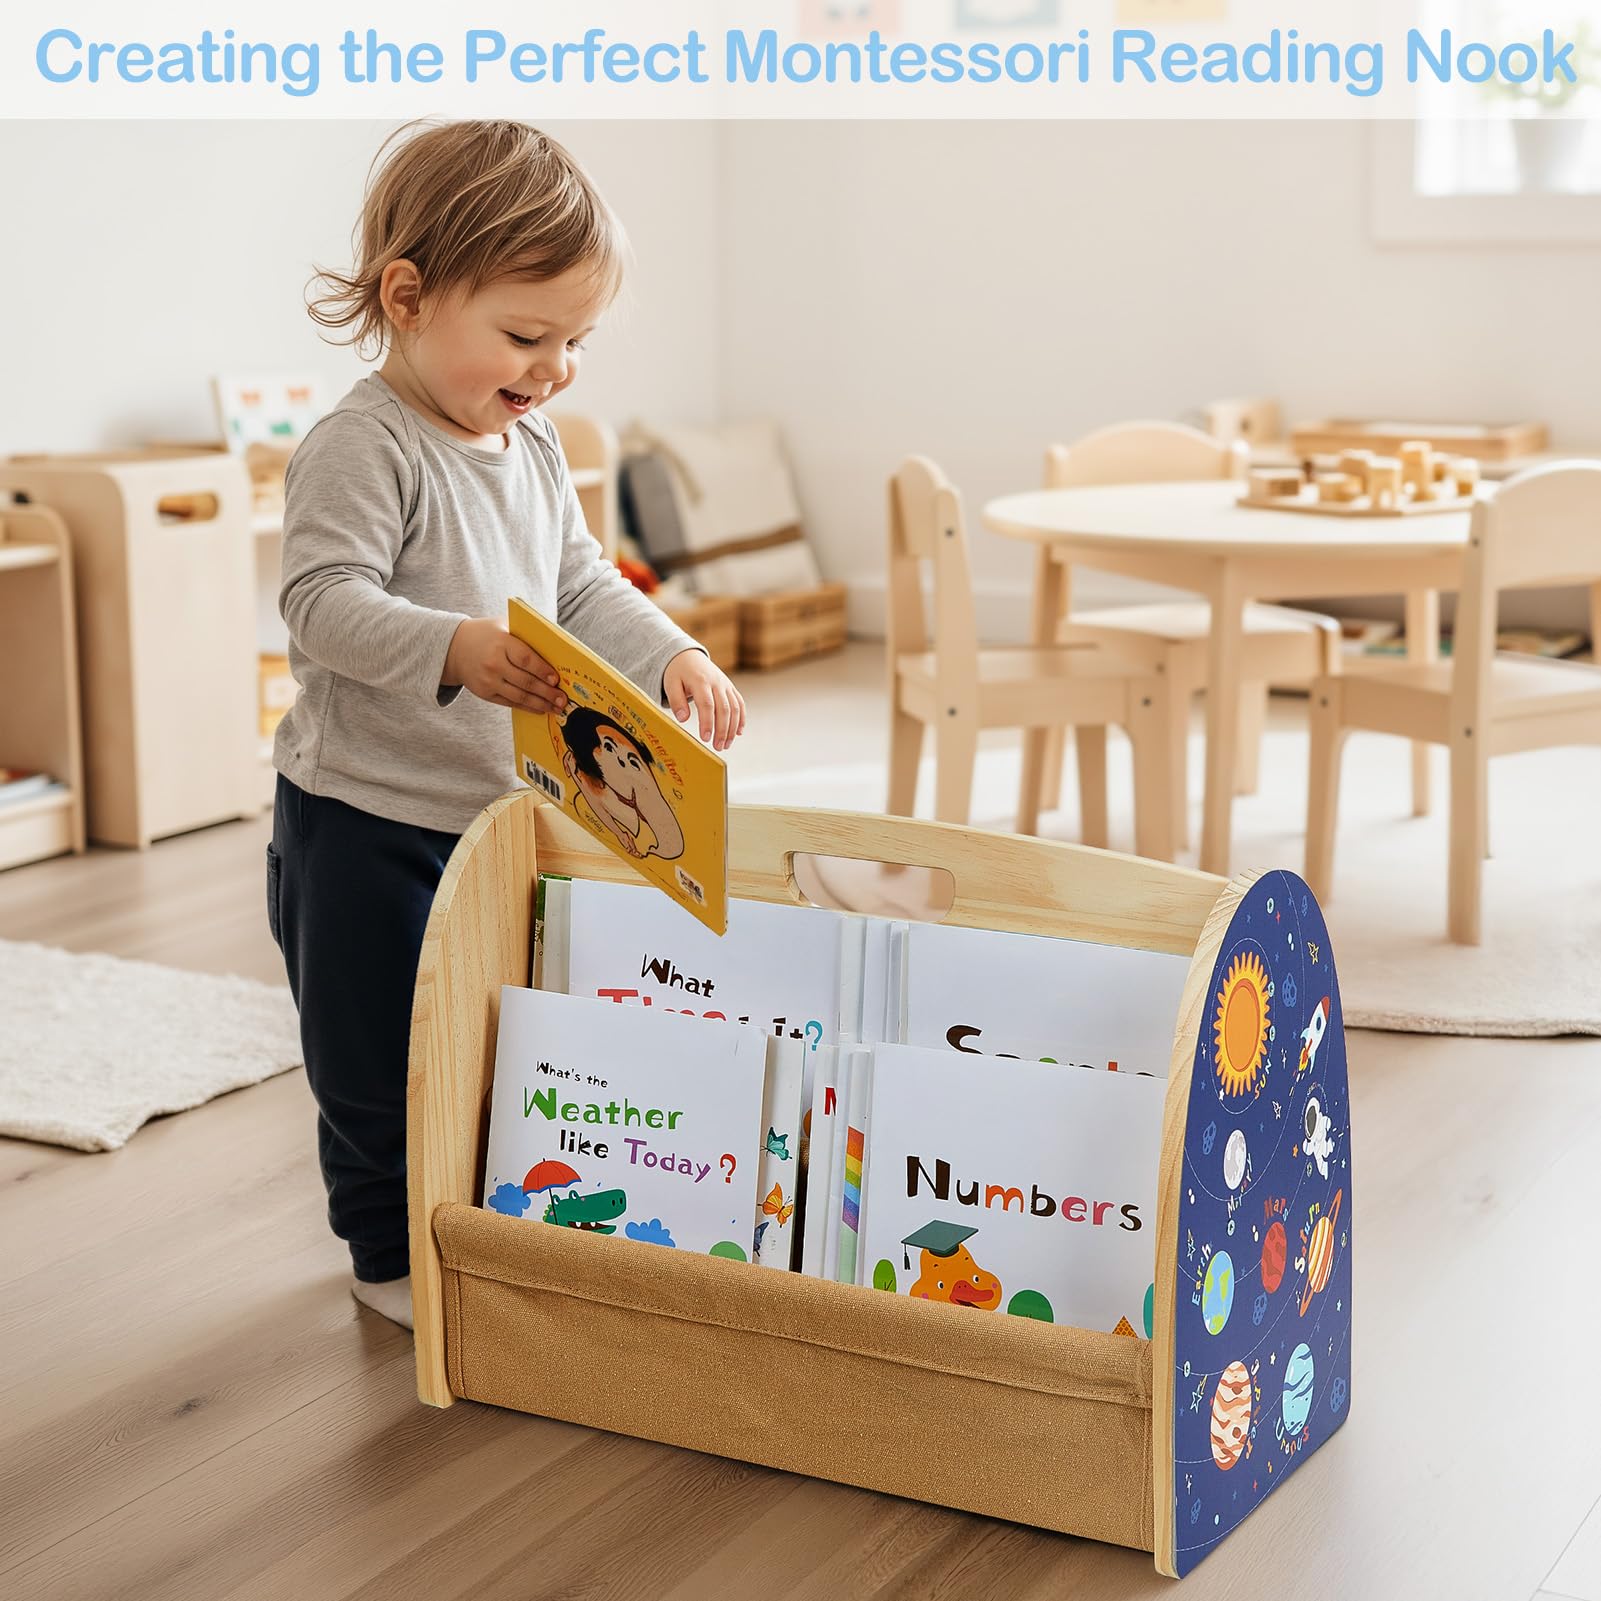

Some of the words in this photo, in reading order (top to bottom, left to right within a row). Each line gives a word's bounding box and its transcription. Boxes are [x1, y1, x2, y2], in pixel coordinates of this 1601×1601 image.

[640, 953, 716, 999] What
[536, 1061, 581, 1083] What's
[587, 1074, 608, 1090] the
[523, 1086, 683, 1130] Weather
[559, 1129, 609, 1160] like
[905, 1155, 1144, 1232] Numbers
[1191, 1243, 1212, 1306] Earth
